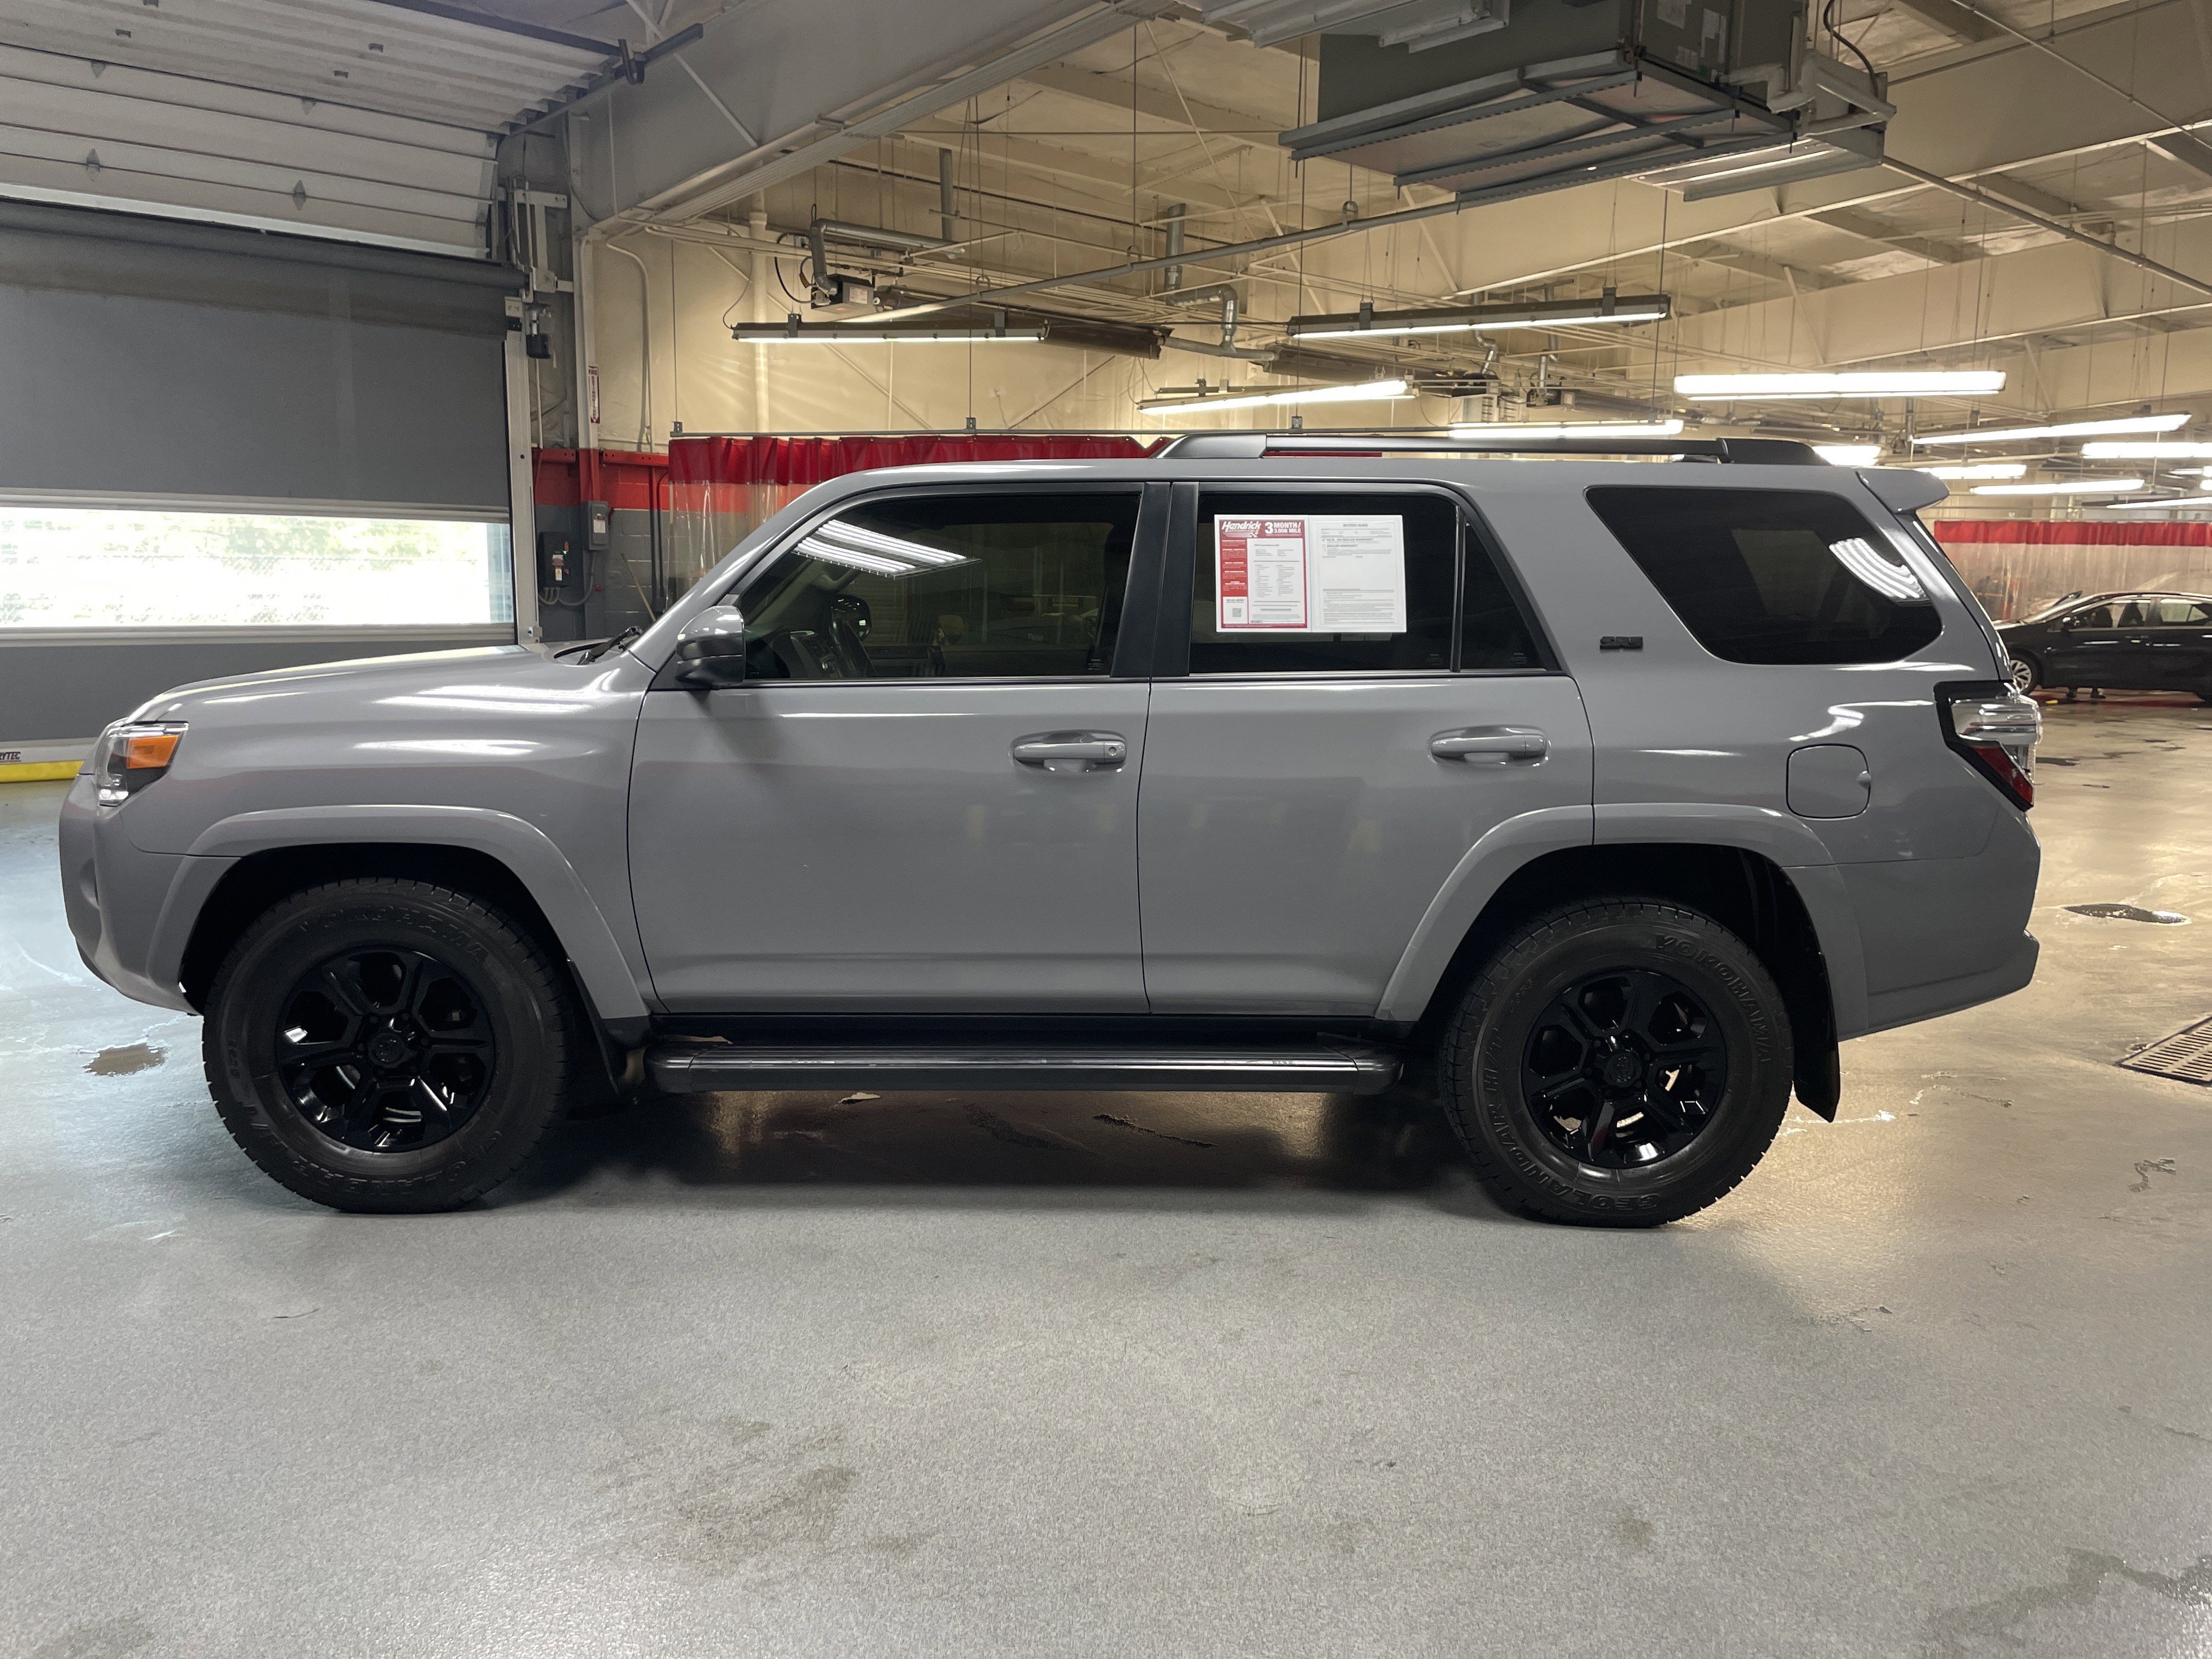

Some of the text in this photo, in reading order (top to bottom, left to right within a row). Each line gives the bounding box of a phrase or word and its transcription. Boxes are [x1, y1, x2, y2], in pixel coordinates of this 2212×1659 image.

[1222, 521, 1262, 532] Hendrick
[1265, 522, 1273, 534] 3
[1654, 932, 1772, 1063] YOKOHAMA
